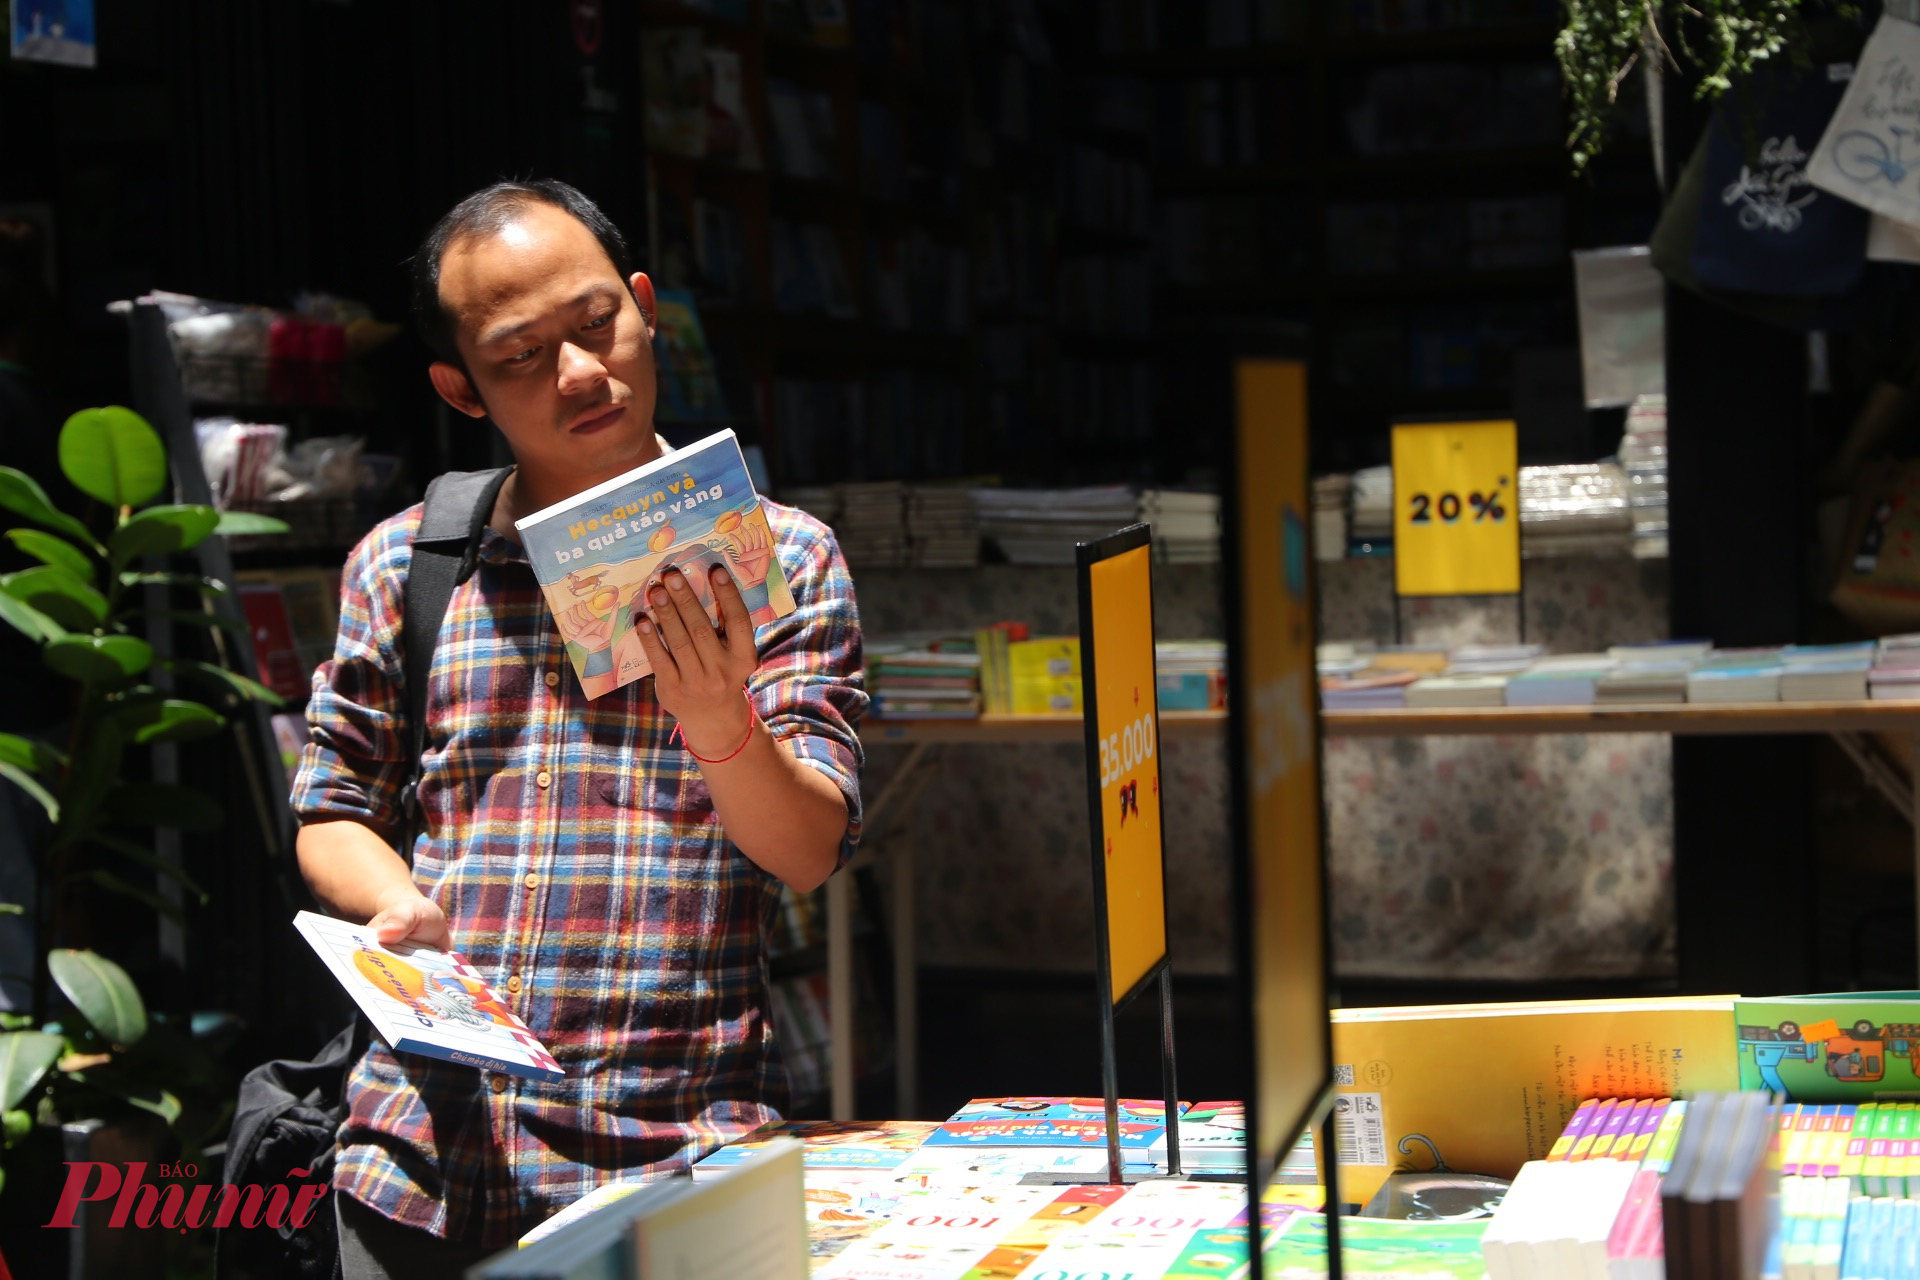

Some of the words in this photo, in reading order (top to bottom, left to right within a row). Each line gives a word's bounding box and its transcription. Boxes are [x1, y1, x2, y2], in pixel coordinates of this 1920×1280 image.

[554, 543, 585, 565] ba
[587, 526, 628, 551] quả
[630, 510, 667, 534] táo
[669, 482, 724, 513] vàng
[567, 488, 666, 541] Hecquyn
[667, 472, 697, 495] và
[1409, 491, 1506, 523] 20%
[1099, 712, 1154, 790] 35.000
